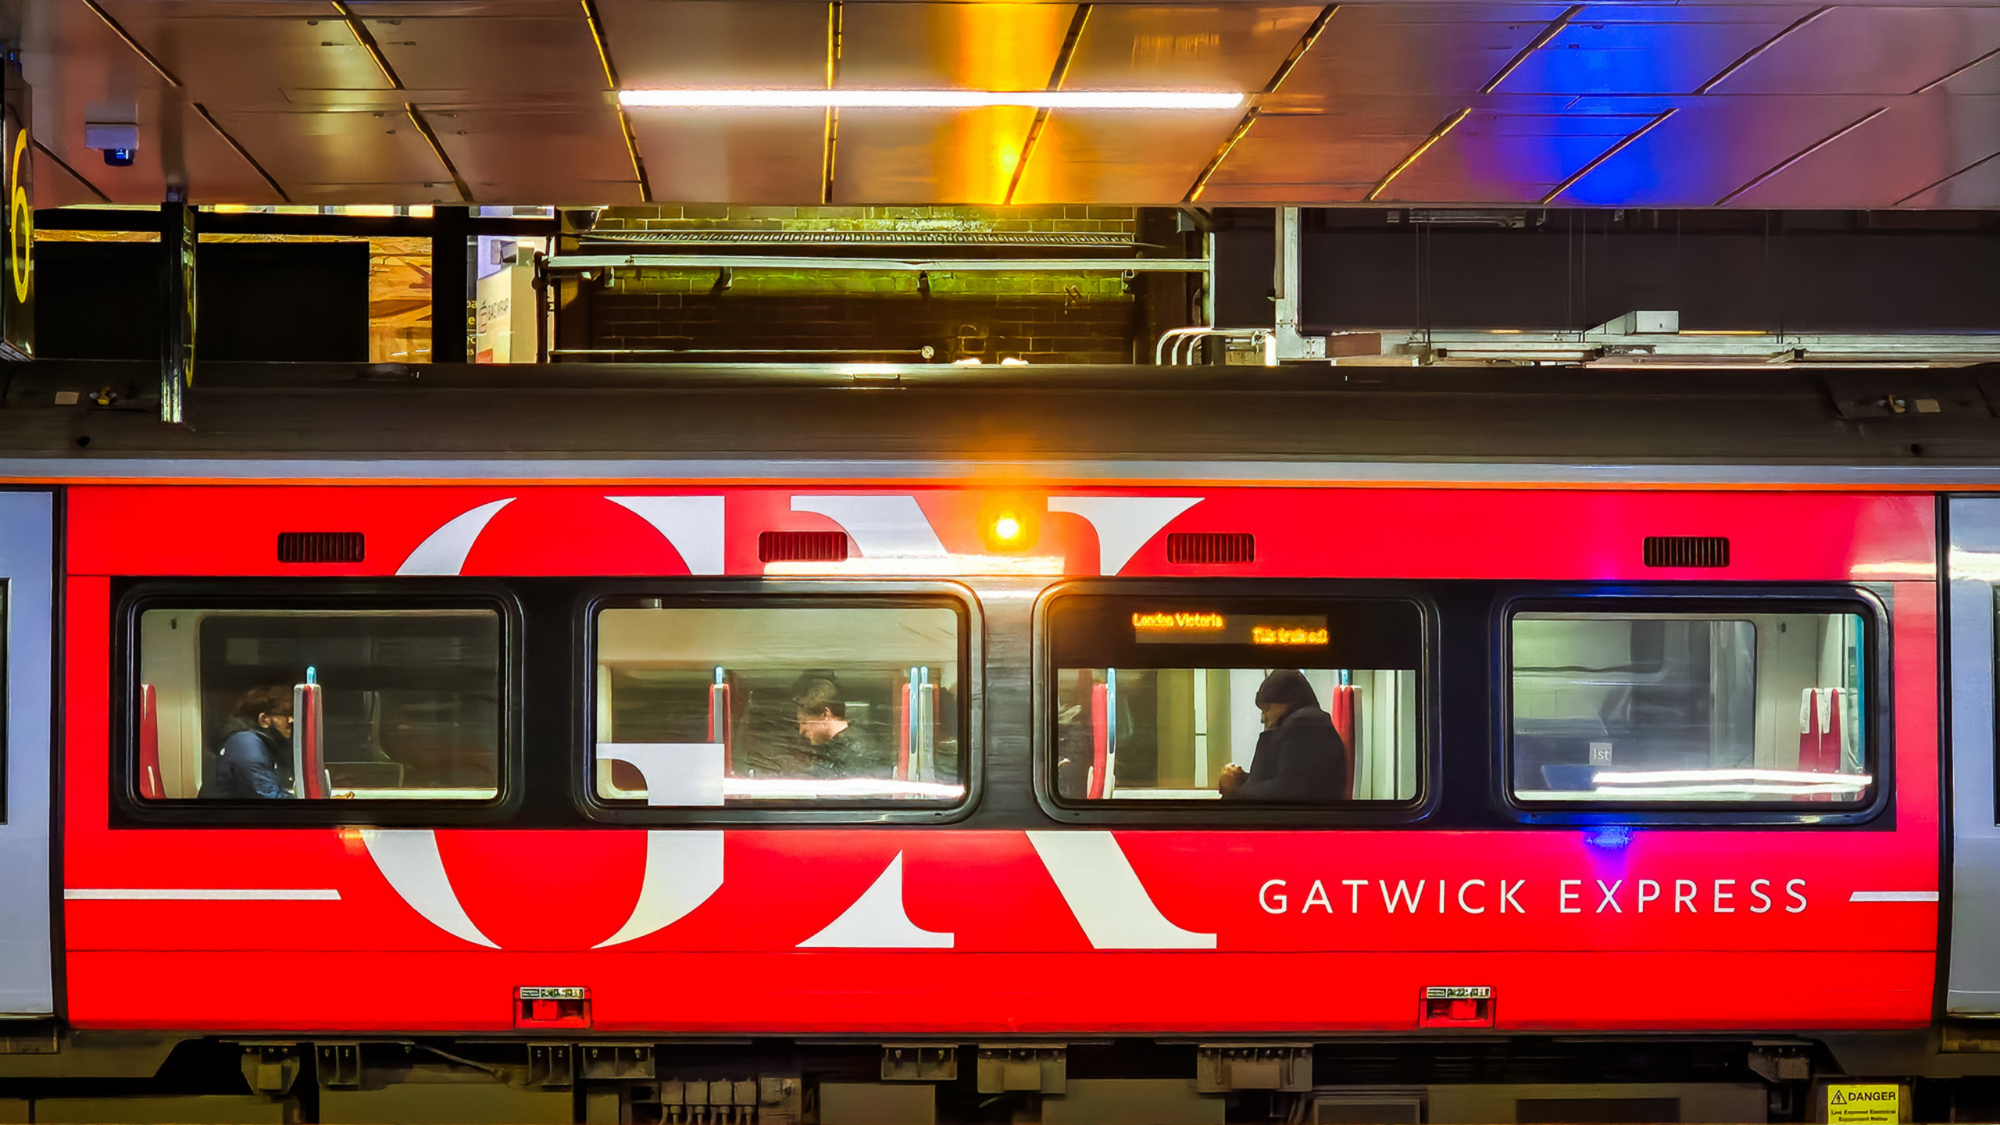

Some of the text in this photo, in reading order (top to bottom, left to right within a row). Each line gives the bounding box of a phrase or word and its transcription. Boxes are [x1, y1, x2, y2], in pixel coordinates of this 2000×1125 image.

[11, 128, 31, 304] 6
[1133, 613, 1223, 628] London Victoria
[1259, 878, 1809, 915] GATWICK EXPRESS
[1848, 1091, 1896, 1101] DANGER
